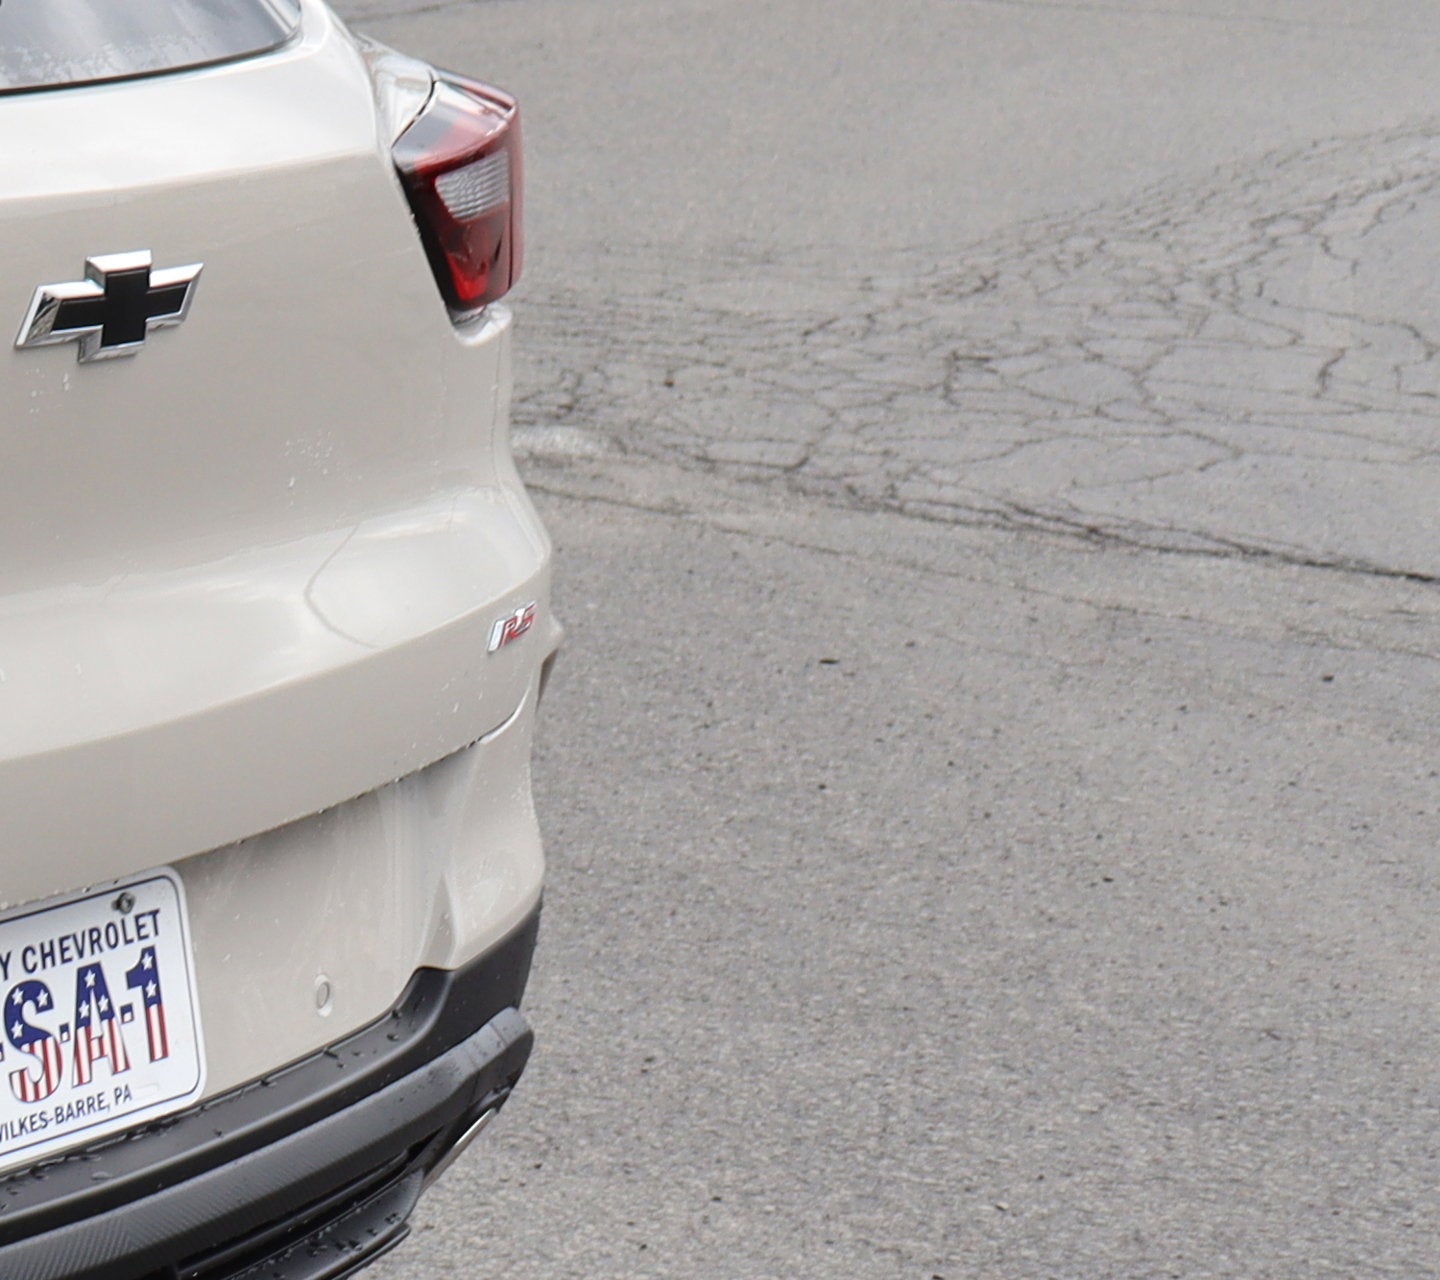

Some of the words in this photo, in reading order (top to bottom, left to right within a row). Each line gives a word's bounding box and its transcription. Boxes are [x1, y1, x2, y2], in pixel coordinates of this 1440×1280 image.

[488, 600, 537, 652] RS
[21, 908, 161, 975] CHEVROLET
[113, 1083, 133, 1103] PA
